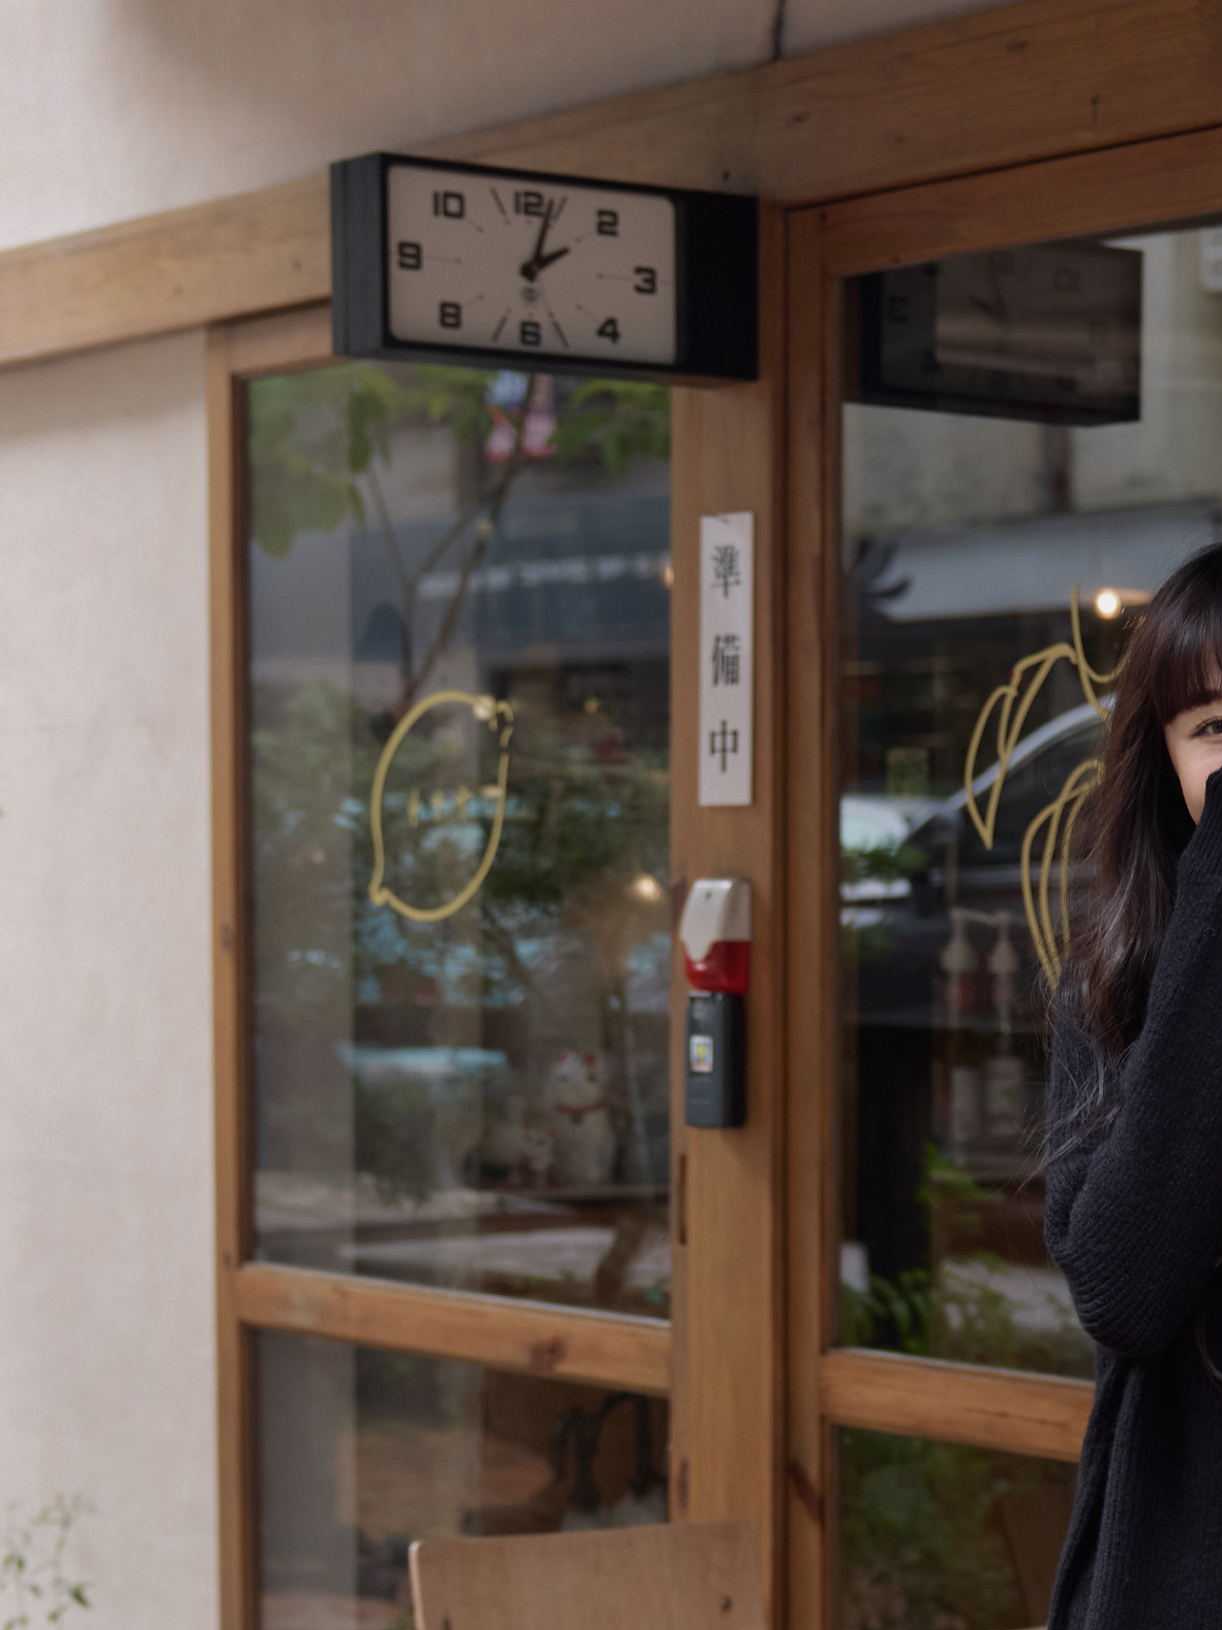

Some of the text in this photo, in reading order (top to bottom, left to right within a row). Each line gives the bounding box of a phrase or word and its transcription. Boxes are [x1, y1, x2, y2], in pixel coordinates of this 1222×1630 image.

[433, 190, 465, 219] 10
[514, 190, 545, 217] 12
[595, 208, 619, 237] 2
[398, 241, 422, 270] 9
[634, 266, 656, 295] 3
[439, 301, 462, 330] 8
[519, 320, 541, 346] 6
[596, 317, 620, 344] 4
[710, 544, 741, 774] 準備中
